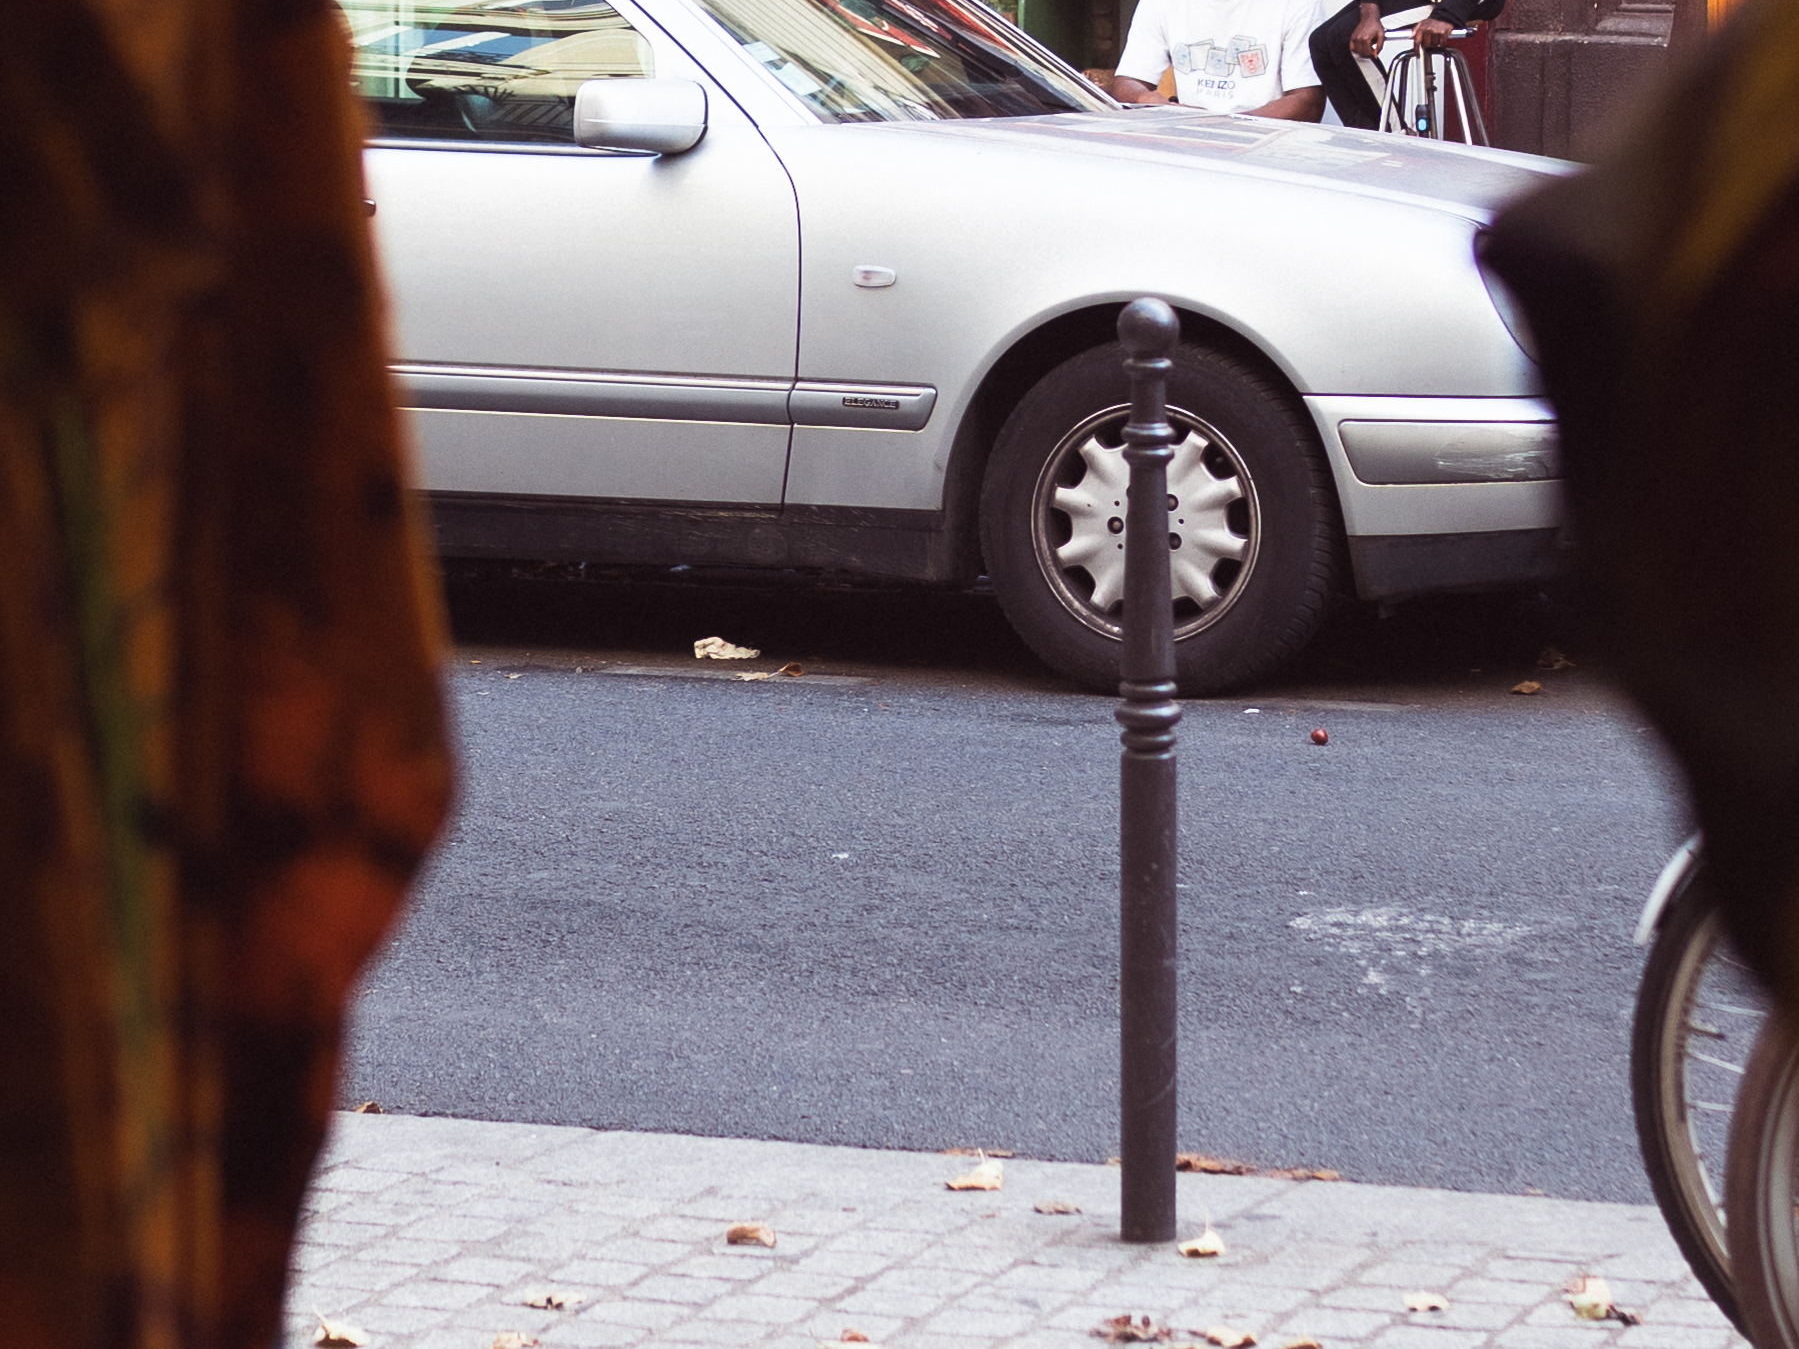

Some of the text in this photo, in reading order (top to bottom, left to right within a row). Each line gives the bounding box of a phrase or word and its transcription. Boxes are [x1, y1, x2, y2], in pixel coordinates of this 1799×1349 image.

[1197, 79, 1236, 90] KENZO
[1196, 88, 1234, 99] PARIS
[843, 396, 897, 409] ELEGANCE
